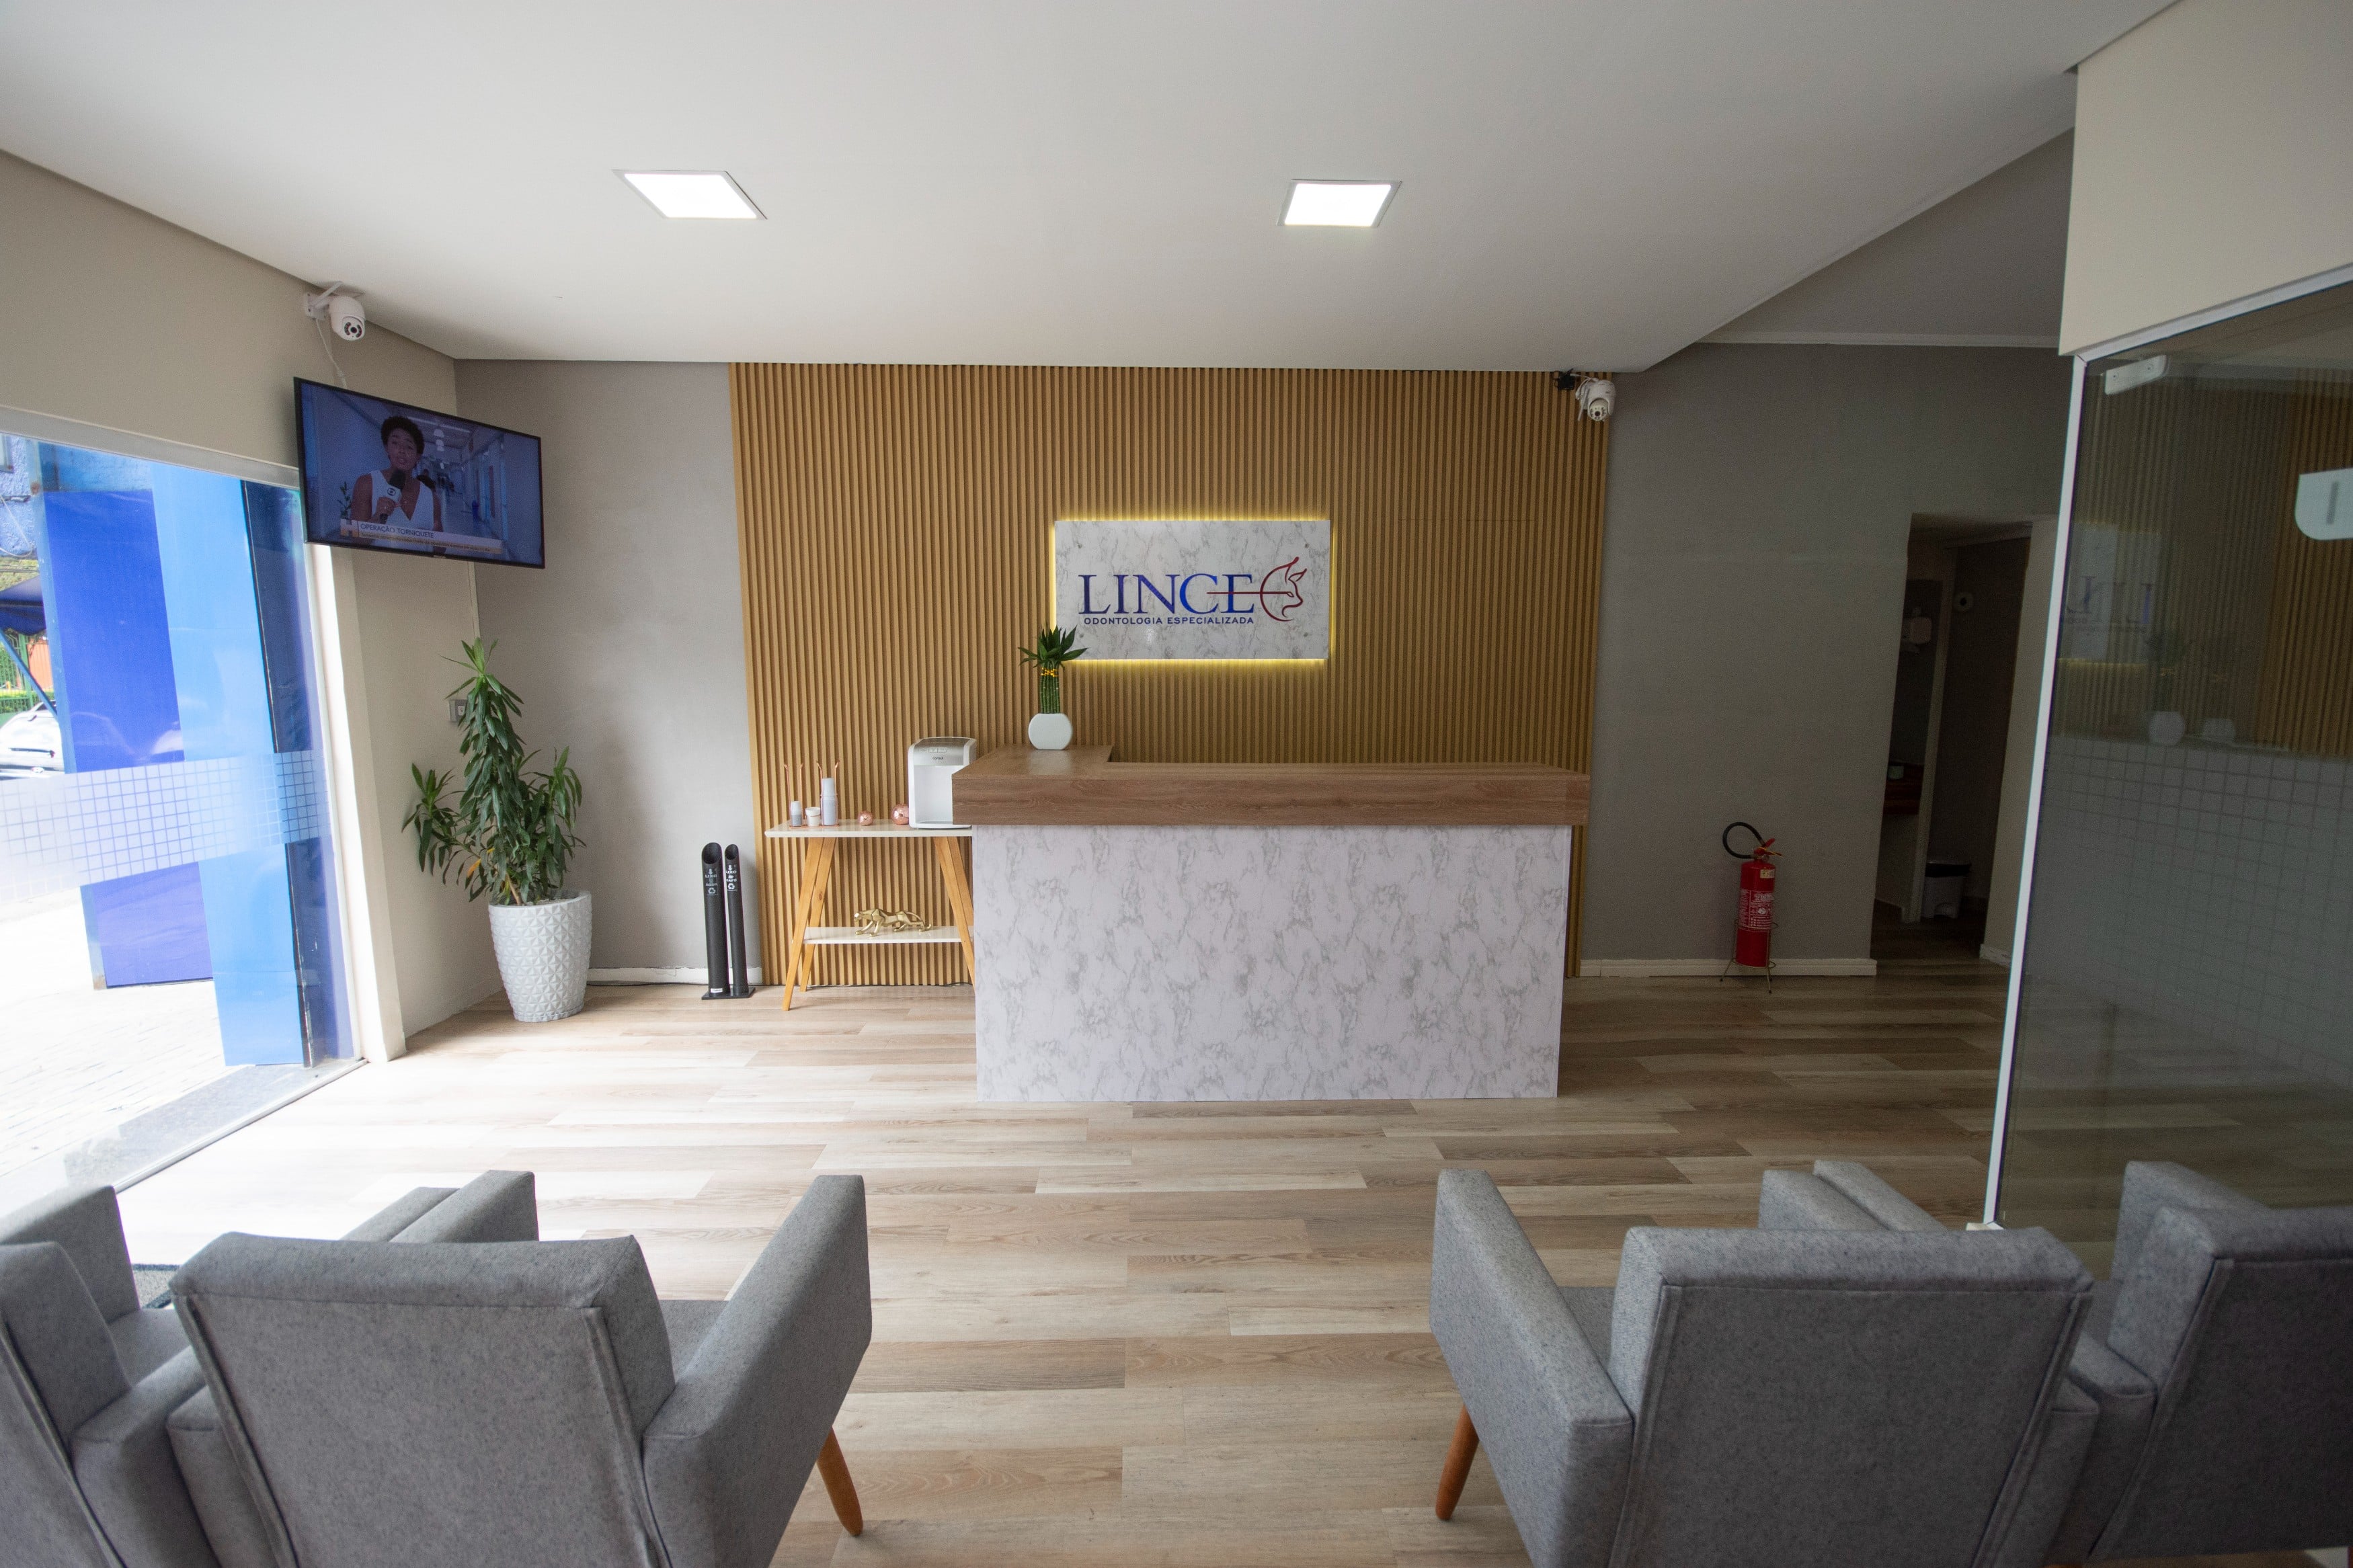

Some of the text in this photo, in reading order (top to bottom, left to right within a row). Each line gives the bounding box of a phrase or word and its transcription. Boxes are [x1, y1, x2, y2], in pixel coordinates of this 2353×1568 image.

[360, 524, 434, 537] OPERAÇÃO TORNIQUETE
[1078, 573, 1254, 614] LINCE
[1084, 616, 1254, 625] ODONTOLOGIA ESPECIALIZADA
